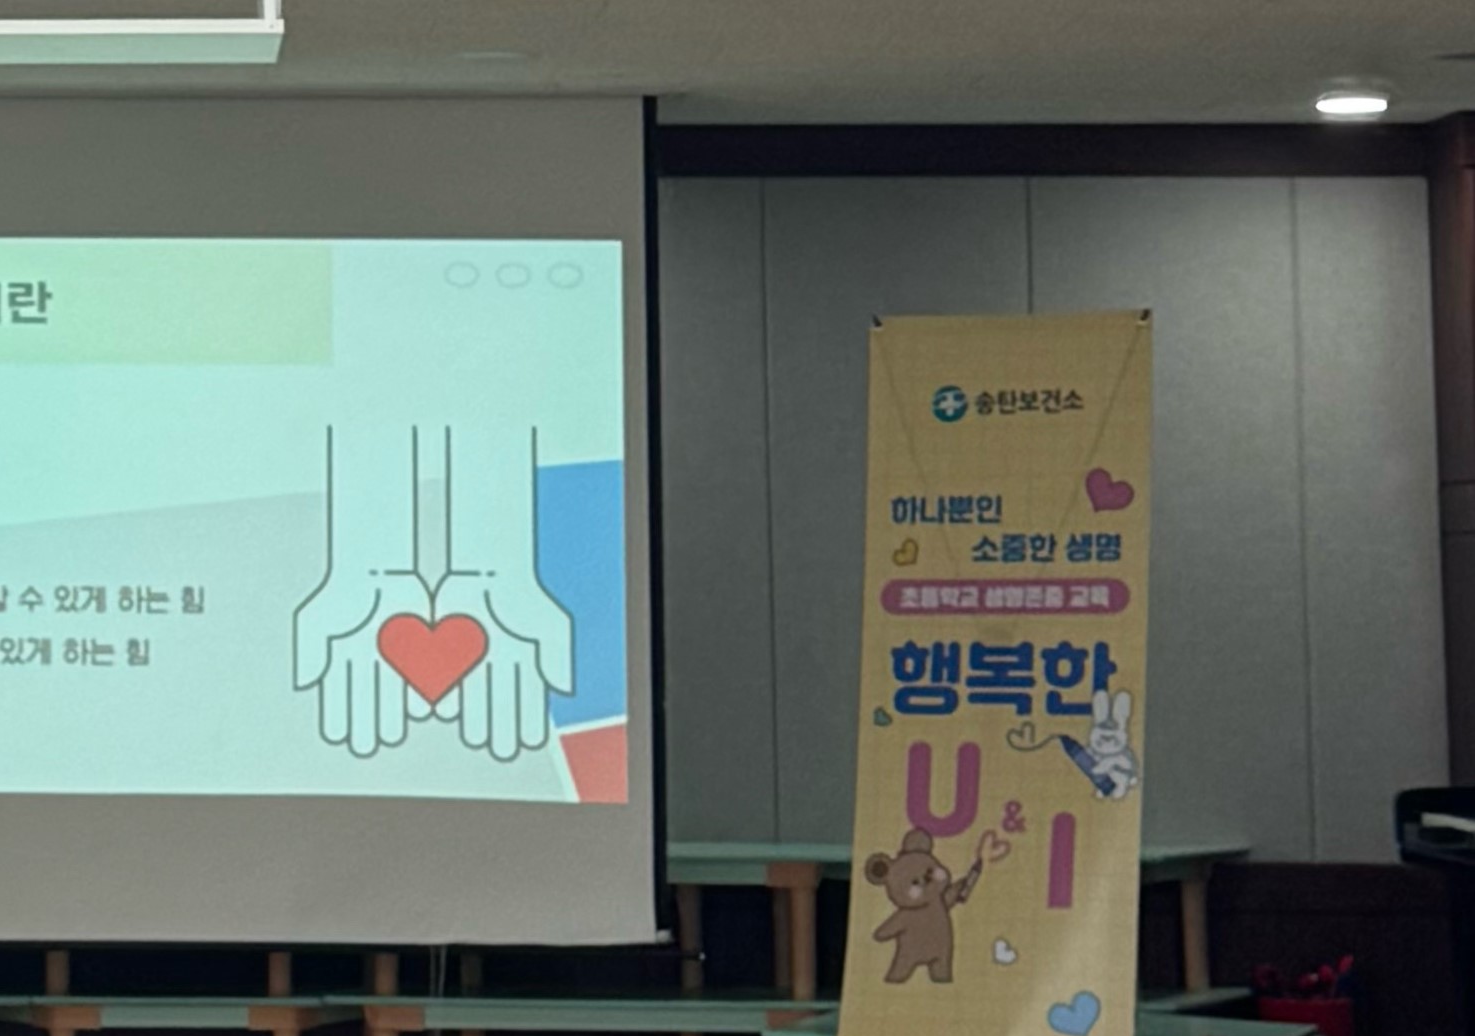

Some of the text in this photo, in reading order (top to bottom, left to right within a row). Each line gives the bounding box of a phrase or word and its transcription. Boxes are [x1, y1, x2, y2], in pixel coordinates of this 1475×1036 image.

[975, 388, 1084, 414] 송탄보건소
[892, 495, 1002, 525] 하나뿐인
[972, 532, 1122, 563] 소중한 생명
[18, 586, 44, 613] 수
[53, 585, 107, 613] 있게
[118, 585, 170, 614] 하는
[182, 585, 204, 614] 힘
[63, 637, 115, 666] 하는
[127, 637, 150, 666] 힘
[892, 641, 1117, 716] 행복한
[906, 740, 1076, 908] U & I
